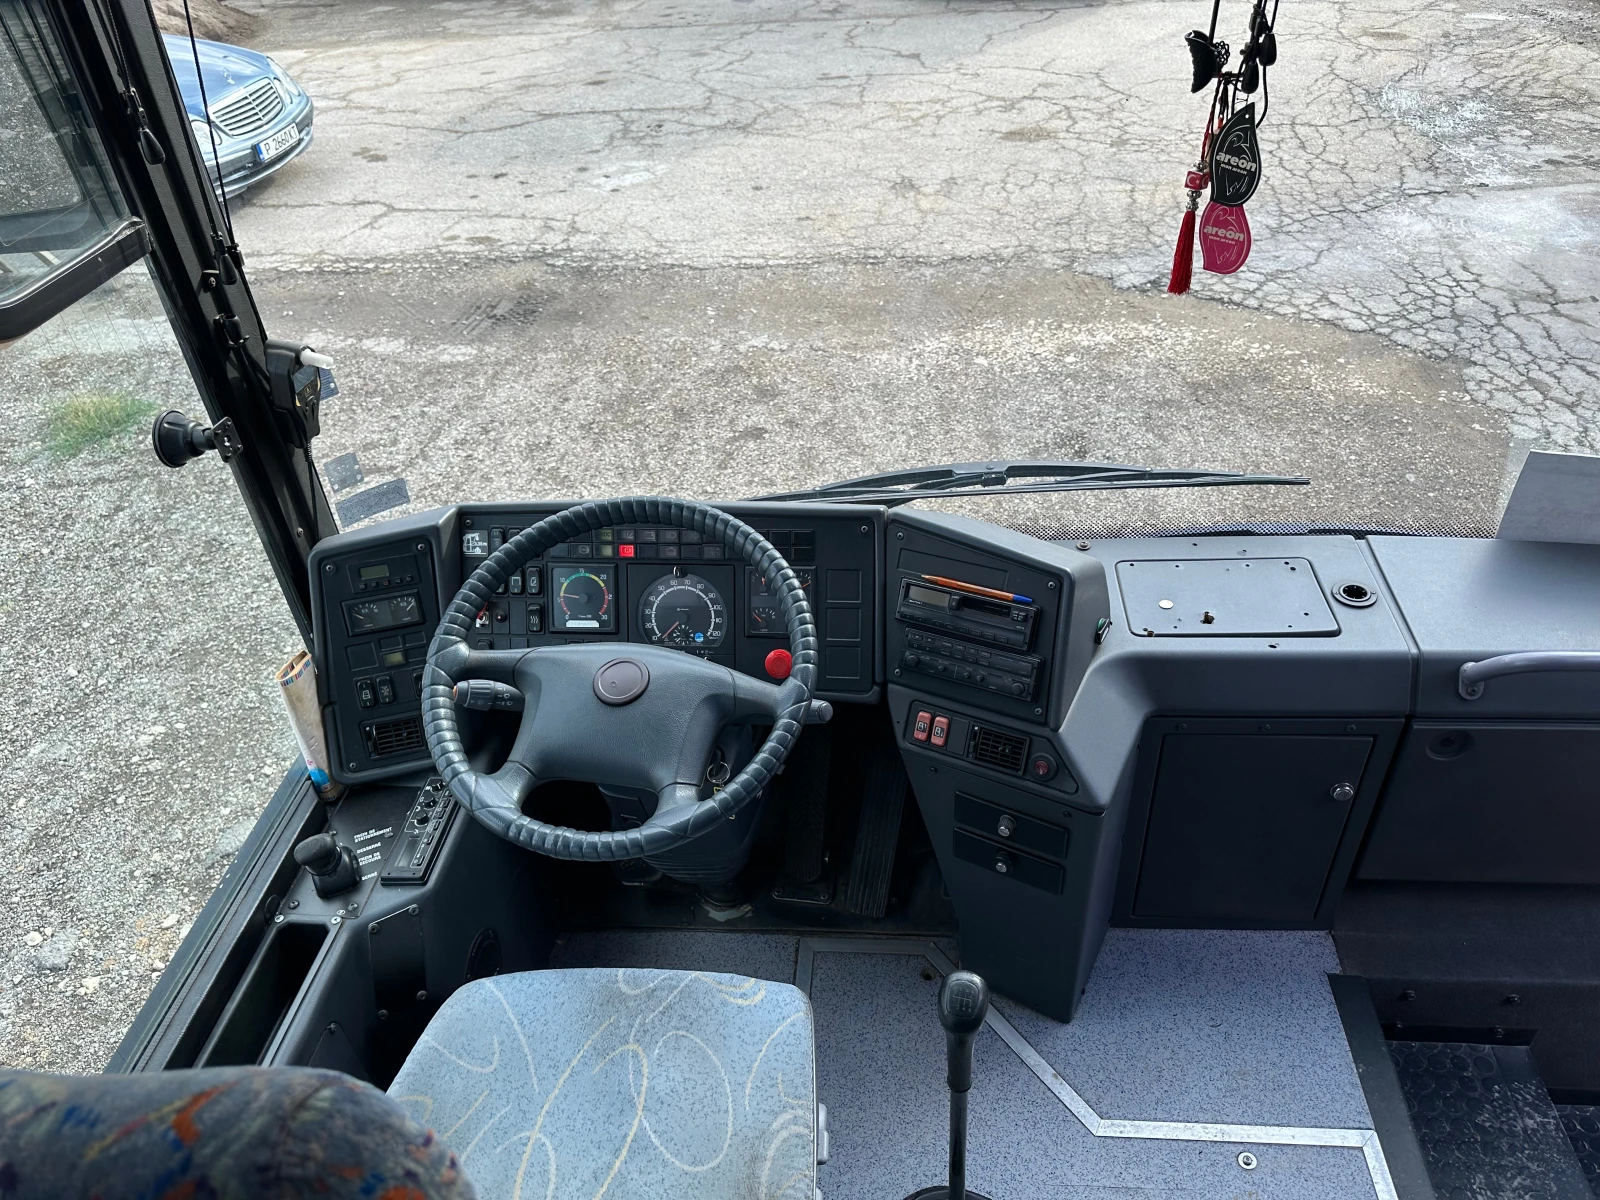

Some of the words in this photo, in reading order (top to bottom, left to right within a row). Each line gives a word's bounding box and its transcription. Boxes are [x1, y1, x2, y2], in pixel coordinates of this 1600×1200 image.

[264, 142, 271, 155] P
[1216, 152, 1257, 172] areon
[1203, 225, 1245, 242] areon
